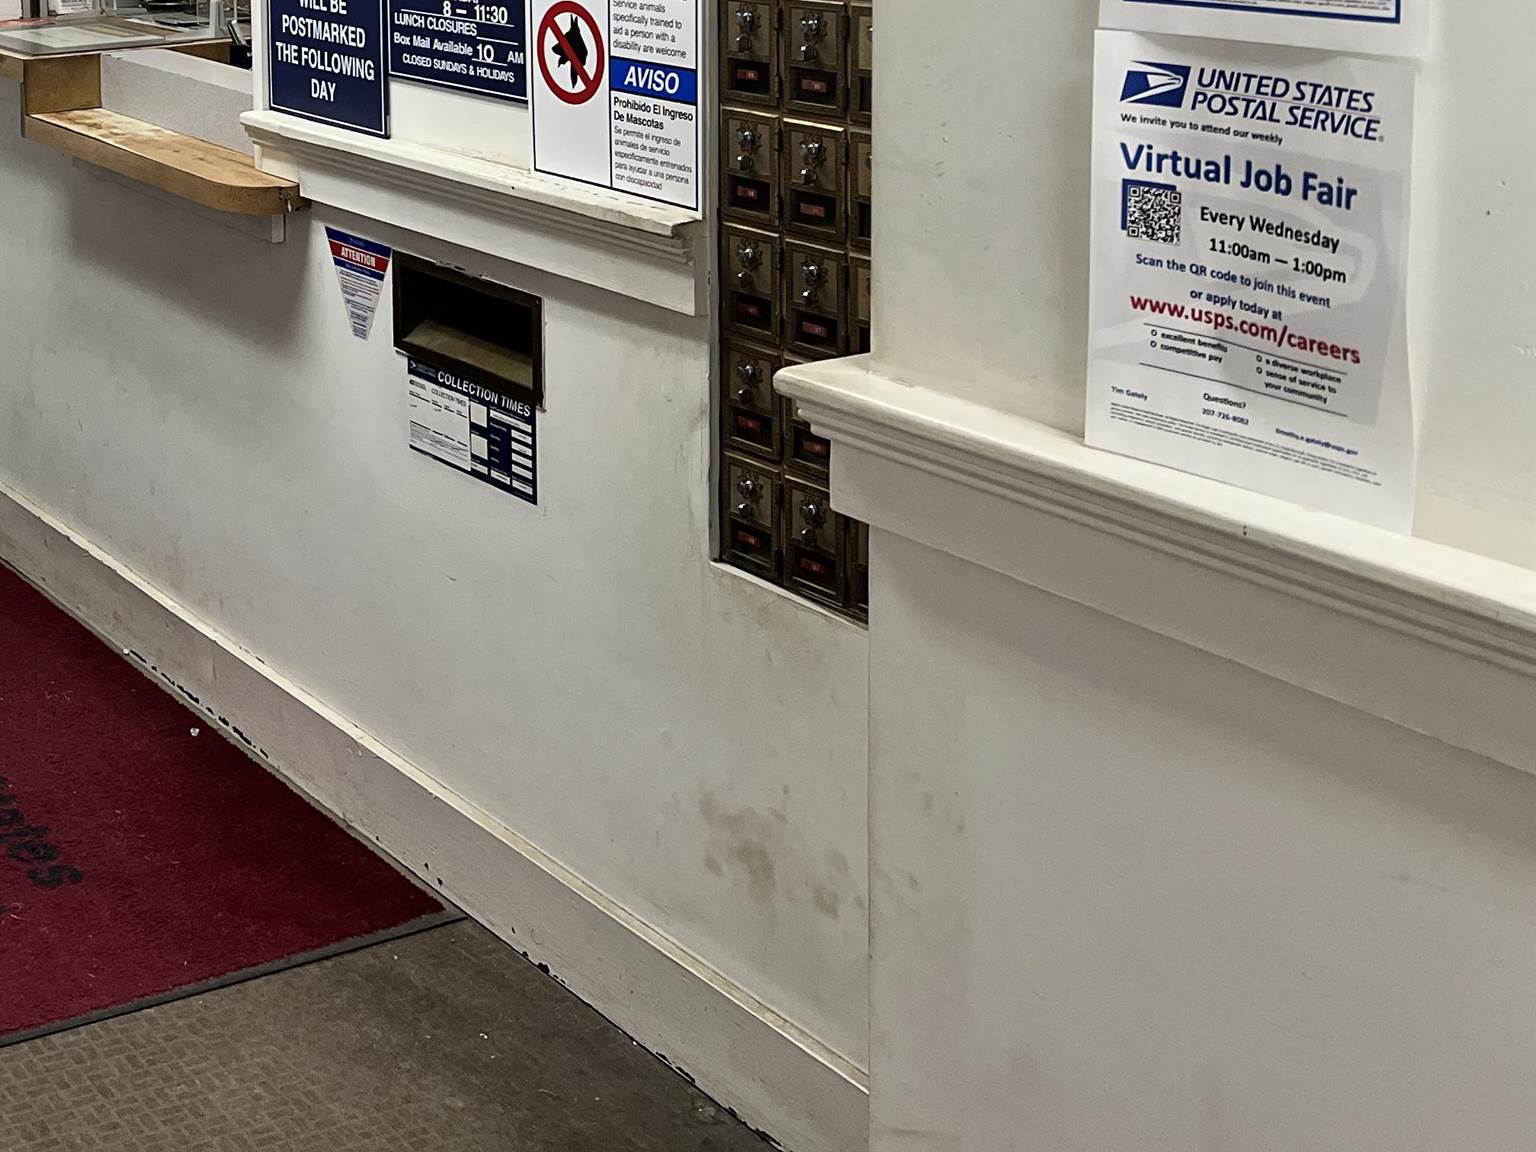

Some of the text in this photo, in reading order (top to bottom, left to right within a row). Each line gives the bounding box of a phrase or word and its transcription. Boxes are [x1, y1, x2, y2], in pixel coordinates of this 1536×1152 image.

[395, 13, 477, 36] LUNCH CLOSURES
[443, 1, 507, 24] 8 11:30
[282, 15, 365, 48] POSTMARKED
[276, 42, 375, 80] THE FOLLOWING
[394, 32, 524, 64] Box Mail Available 10 AM
[403, 53, 514, 83] CLOSED SUNDAYS & HOLIDAYS
[624, 66, 679, 94] AVISO
[311, 78, 336, 102] DAY
[1197, 67, 1375, 112] UNITED STATES
[614, 97, 693, 121] Prohibido El Ingreso
[614, 111, 664, 130] De Mascotas
[1191, 91, 1380, 142] POSTAL SERVICE
[1121, 113, 1283, 145] We invite you to attend our weekly
[1120, 142, 1357, 210] Virtual Job Fair
[1200, 207, 1340, 253] Every Wednesday
[341, 246, 376, 268] ATTENTION
[1209, 238, 1346, 283] 11:00am 1:00pm
[1130, 295, 1361, 364] www.usps.com/careers
[438, 371, 498, 404] COLLECTION
[501, 397, 530, 417] TIMES
